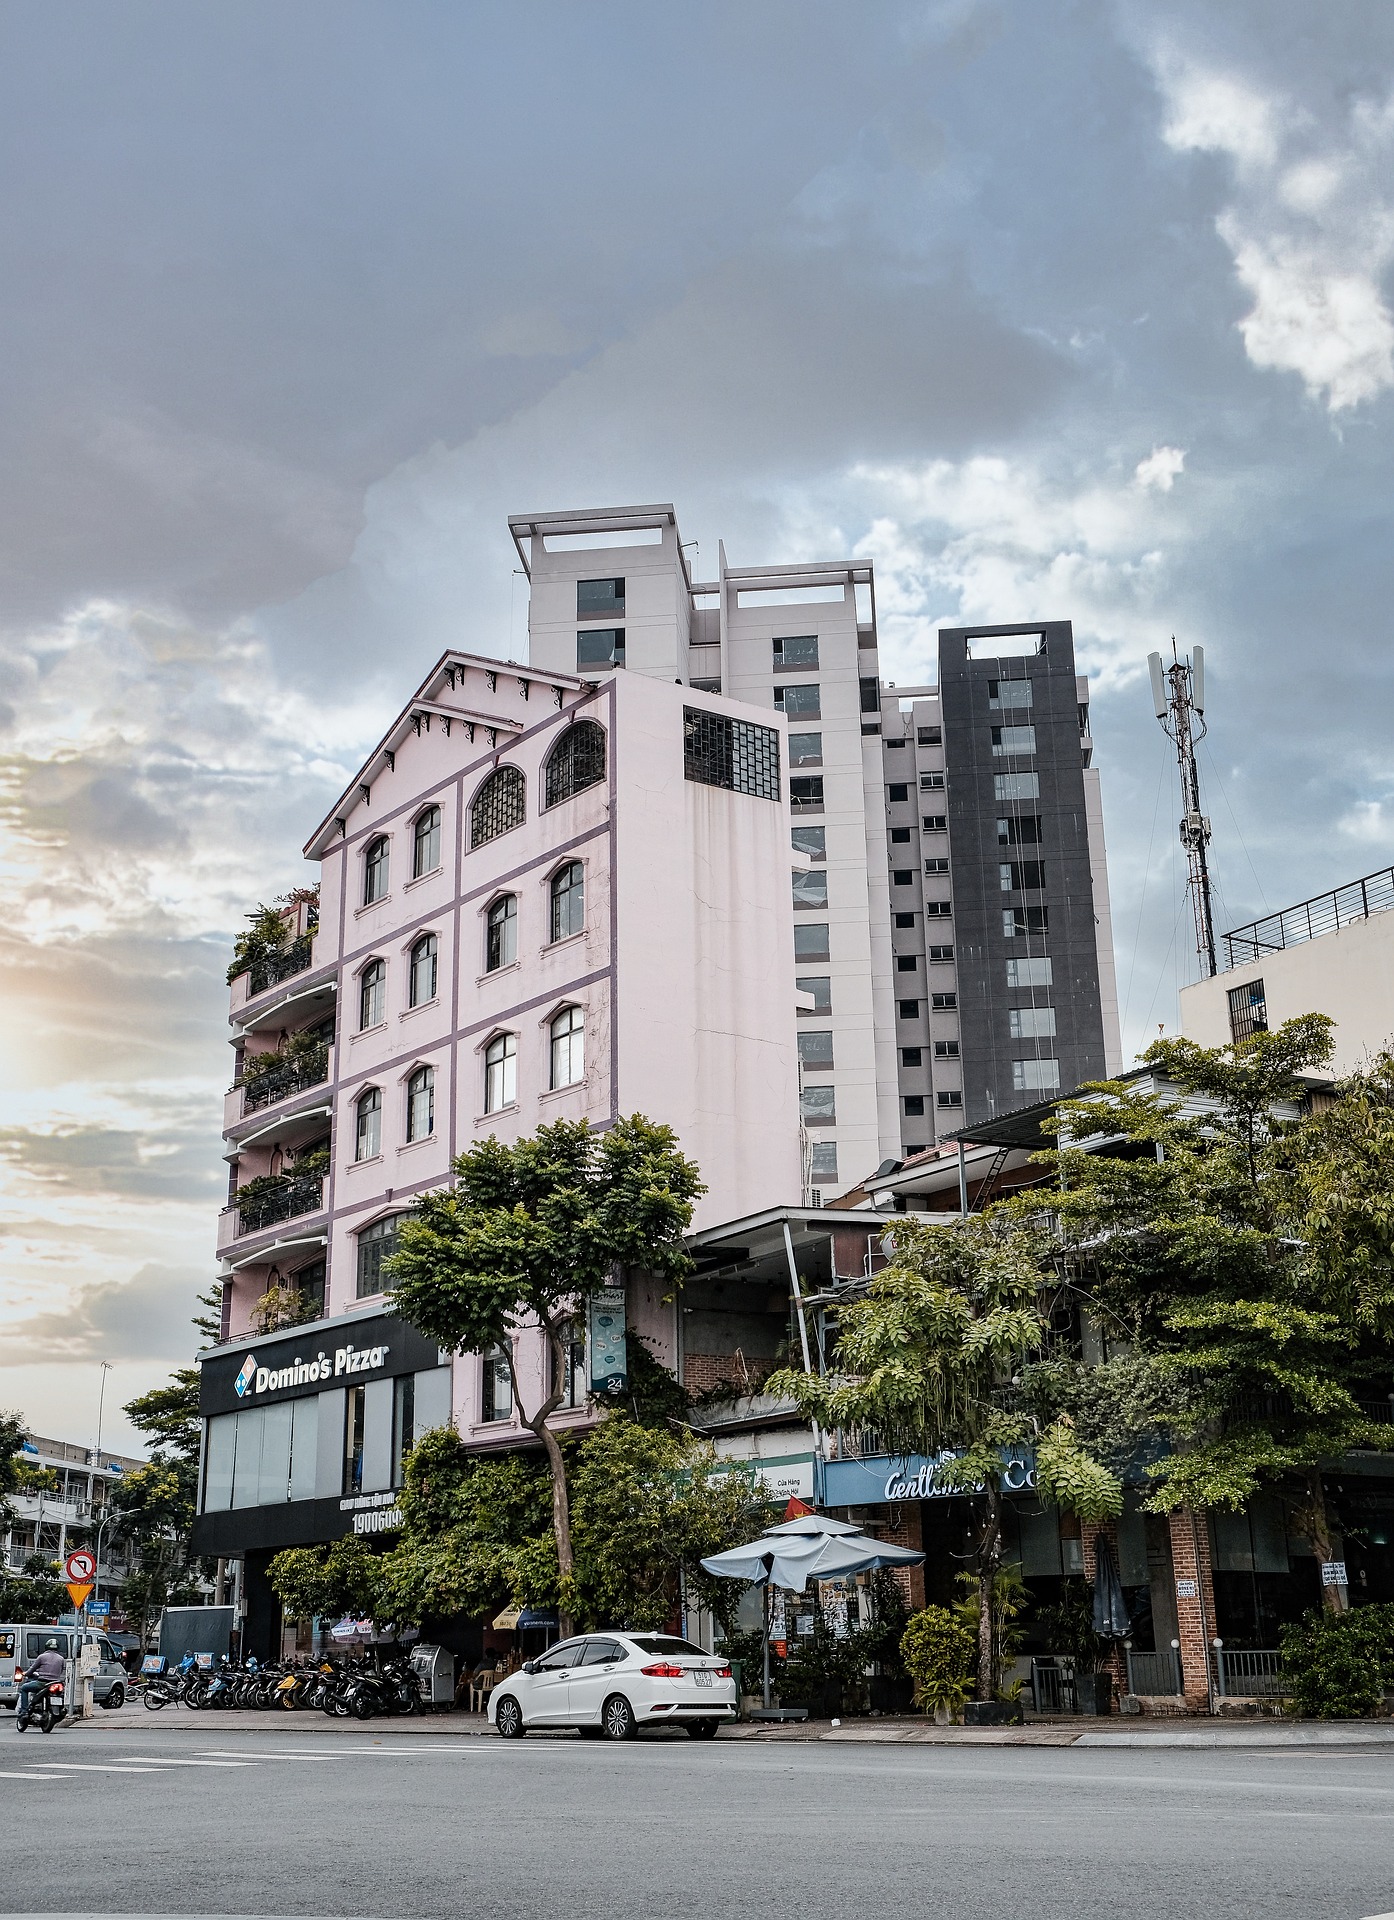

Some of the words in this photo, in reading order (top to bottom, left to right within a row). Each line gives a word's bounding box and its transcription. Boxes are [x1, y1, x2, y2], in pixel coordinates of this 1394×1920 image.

[255, 1352, 333, 1394] Domino's
[334, 1345, 386, 1377] Pizza
[607, 1378, 622, 1390] 24
